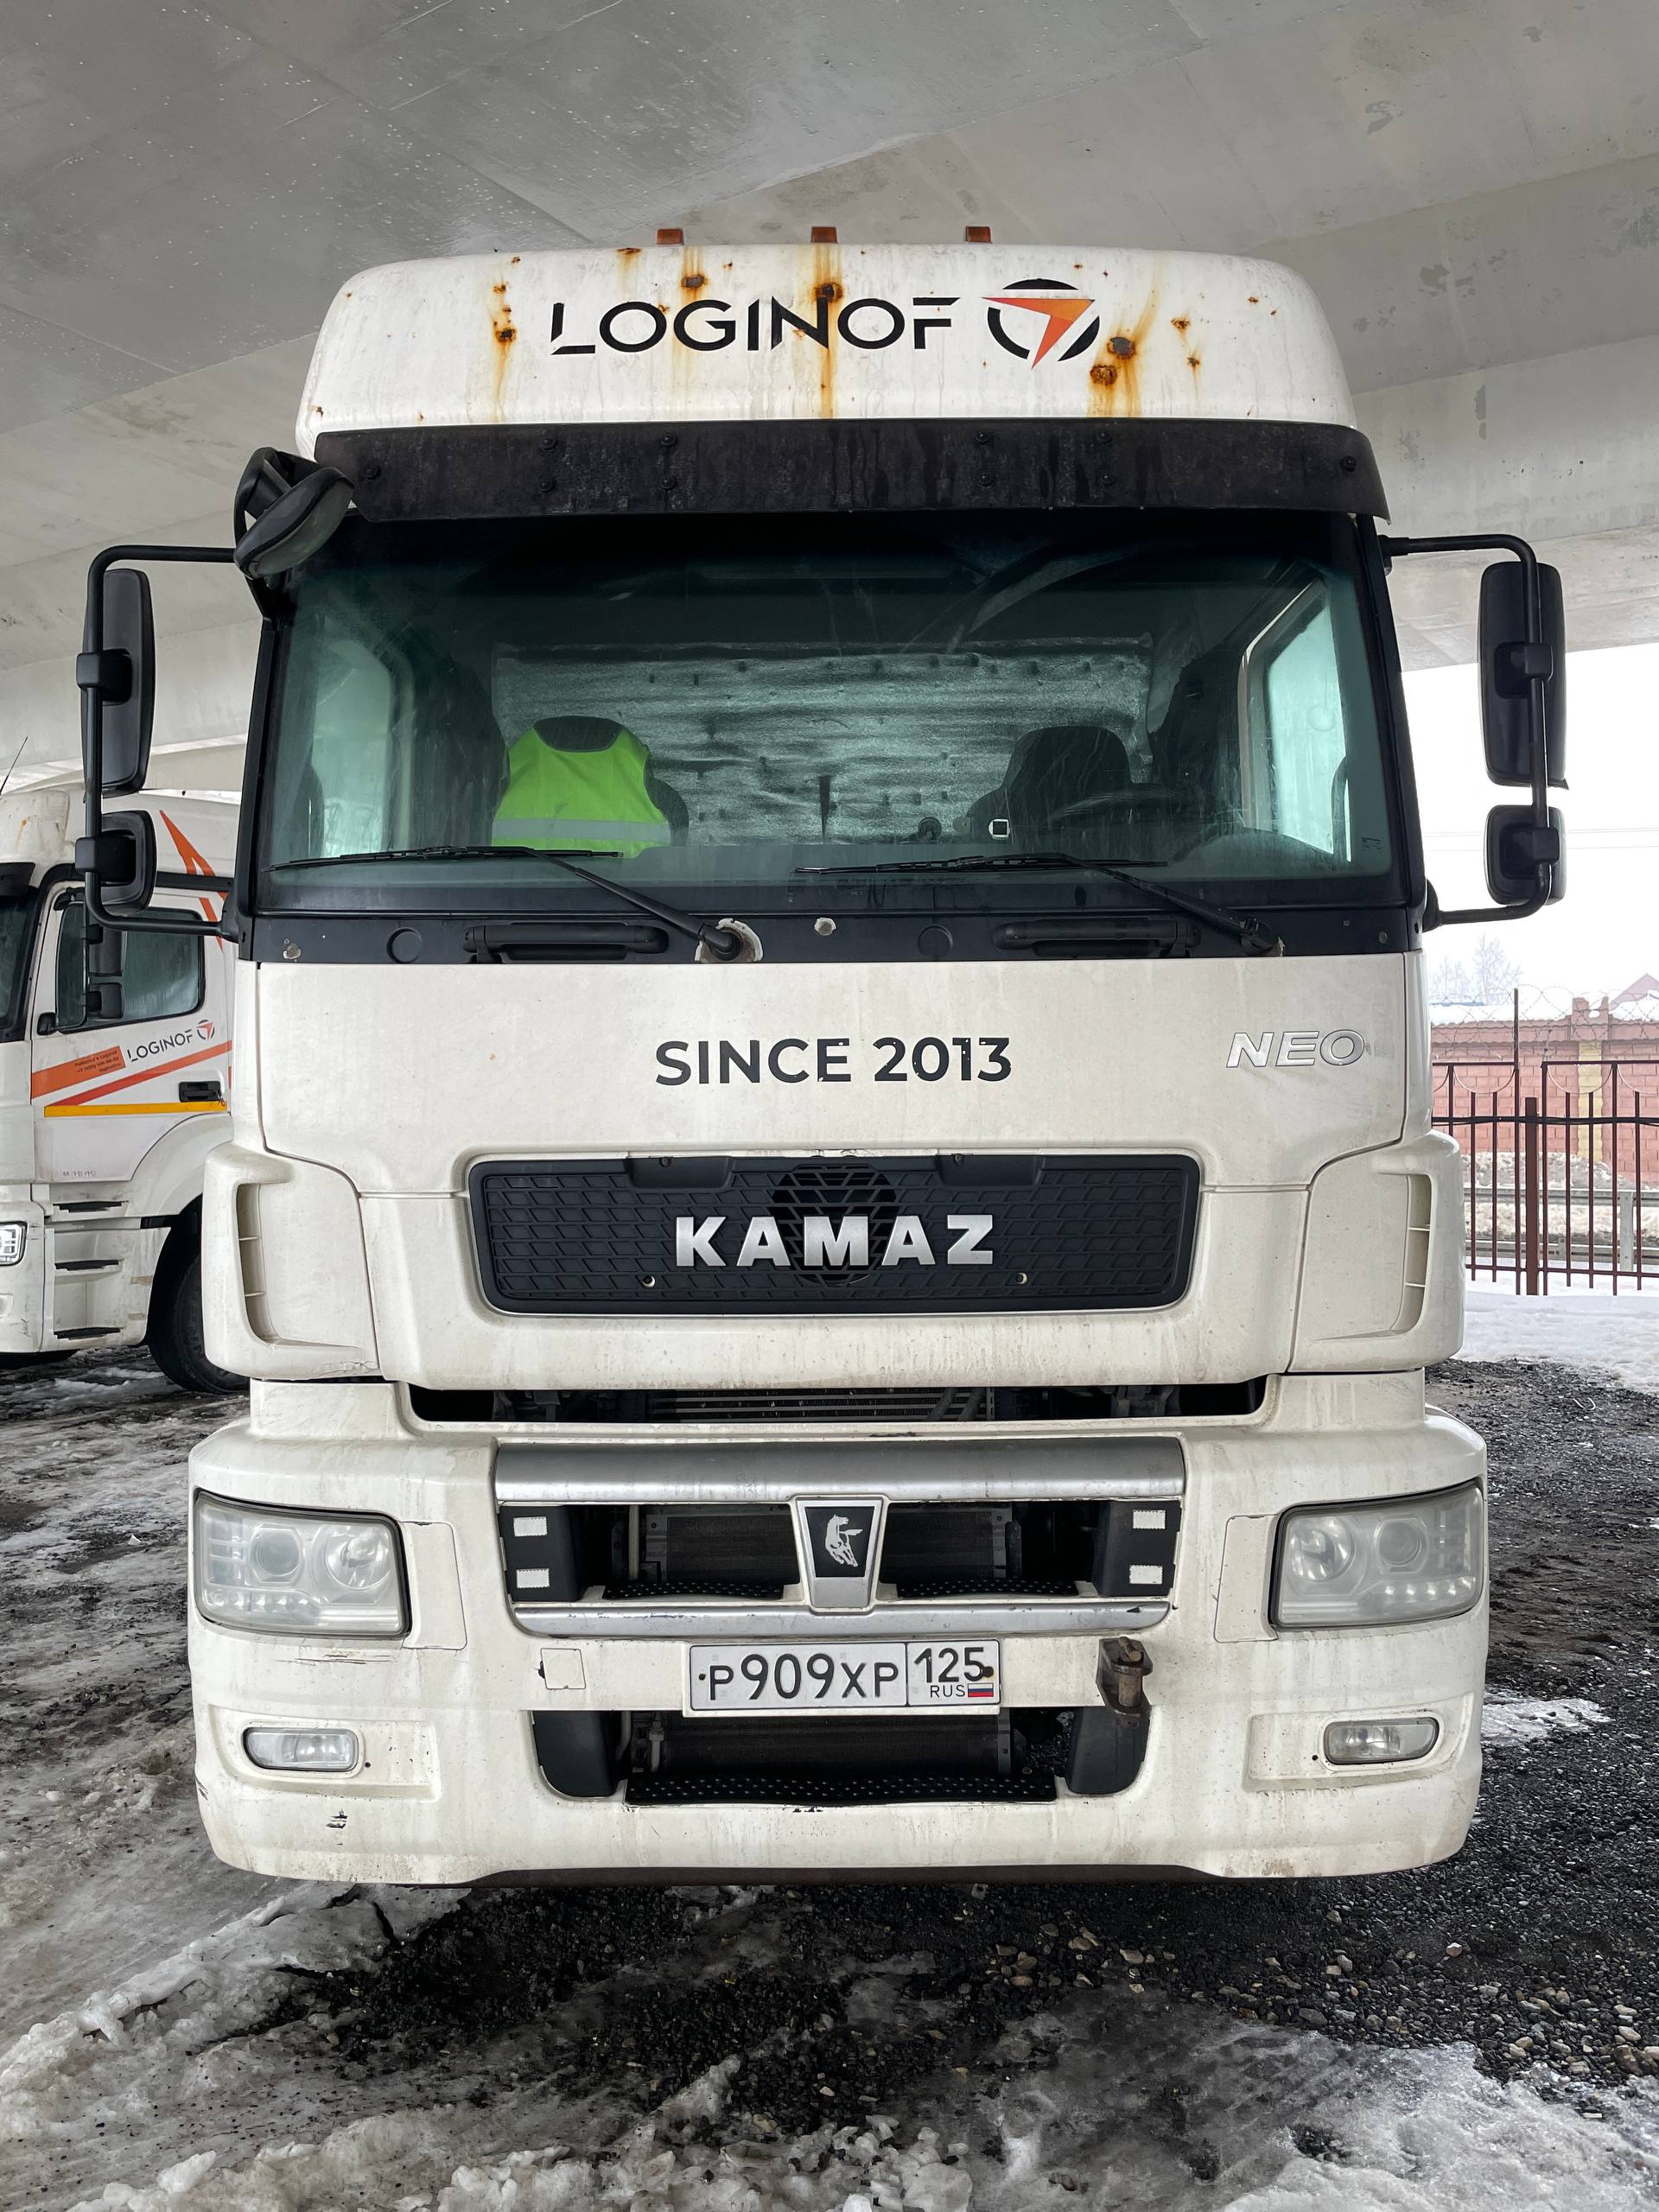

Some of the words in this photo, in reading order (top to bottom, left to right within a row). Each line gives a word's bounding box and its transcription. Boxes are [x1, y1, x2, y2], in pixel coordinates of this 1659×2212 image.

[550, 296, 960, 355] LOGINOF
[127, 1029, 193, 1062] LOGINOF
[656, 1038, 851, 1086] SINCE
[872, 1037, 1012, 1082] 2013
[1226, 1029, 1364, 1068] NEO
[676, 1214, 994, 1267] KAMAZ
[914, 1647, 984, 1683] 125
[930, 1684, 965, 1698] RUS
